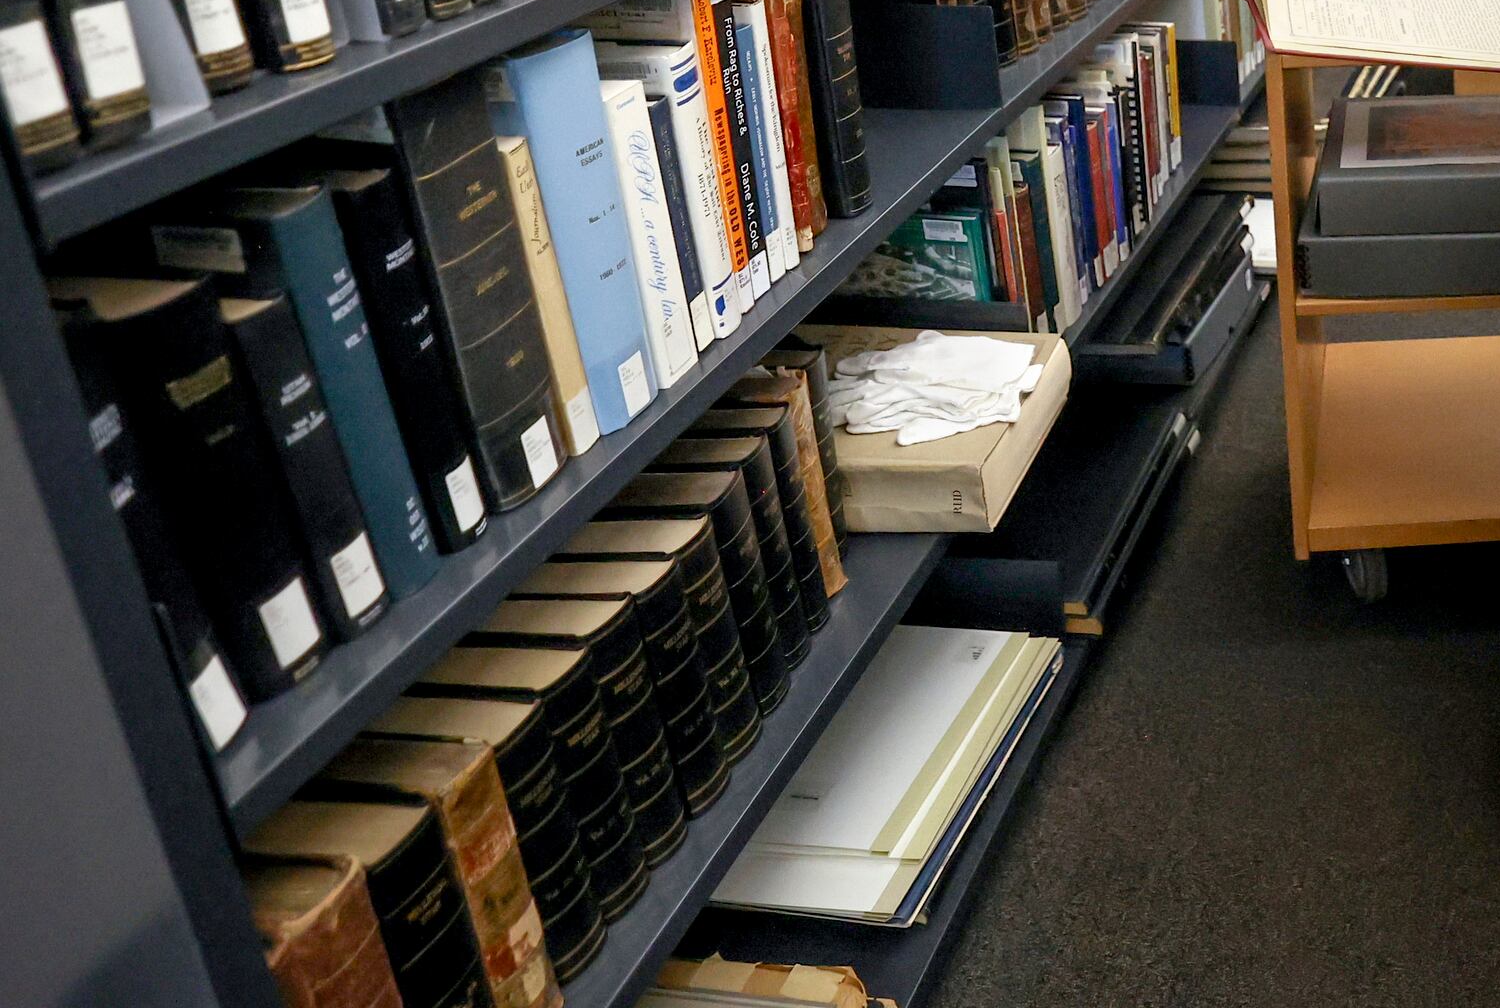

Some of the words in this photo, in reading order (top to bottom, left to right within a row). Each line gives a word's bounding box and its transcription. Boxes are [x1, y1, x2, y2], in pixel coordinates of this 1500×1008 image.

[724, 17, 733, 48] From
[703, 38, 718, 85] Karolevitz
[728, 48, 738, 74] Rag
[722, 68, 731, 95] Ruin
[732, 75, 739, 87] to
[733, 88, 745, 125] Riches
[714, 107, 731, 176] Newspapering
[739, 126, 748, 137] &
[575, 137, 605, 158] AMERICAN
[580, 150, 603, 168] ESSAYS
[724, 177, 732, 187] in
[740, 162, 752, 201] Diane
[726, 189, 734, 205] the
[728, 206, 740, 233] OLD
[746, 201, 755, 220] M.
[643, 219, 656, 232] a
[748, 220, 759, 251] Cole
[647, 236, 668, 292] century
